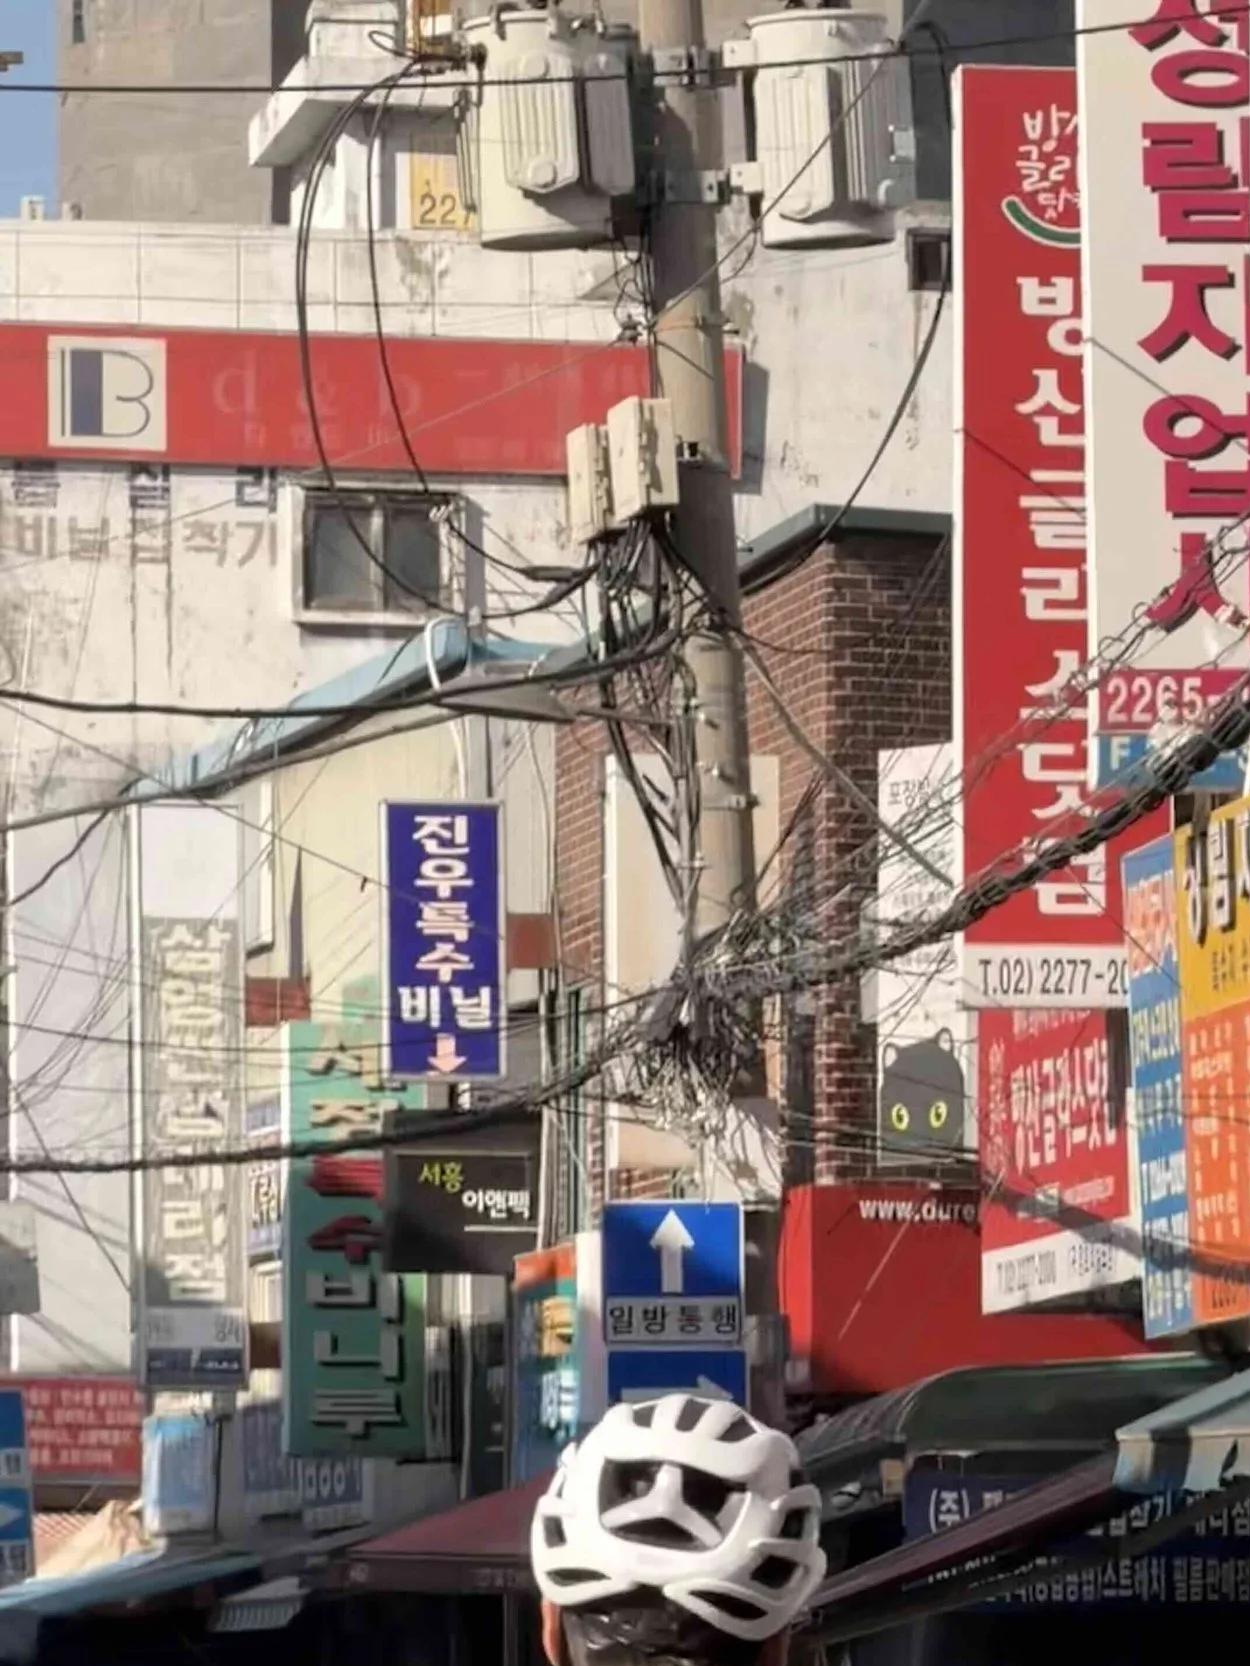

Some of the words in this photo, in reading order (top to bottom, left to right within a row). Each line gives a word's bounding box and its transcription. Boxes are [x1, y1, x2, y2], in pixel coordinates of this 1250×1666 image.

[411, 814, 475, 984] 진우특수
[398, 985, 493, 1030] 비닐
[608, 1304, 738, 1336] 일방통행
